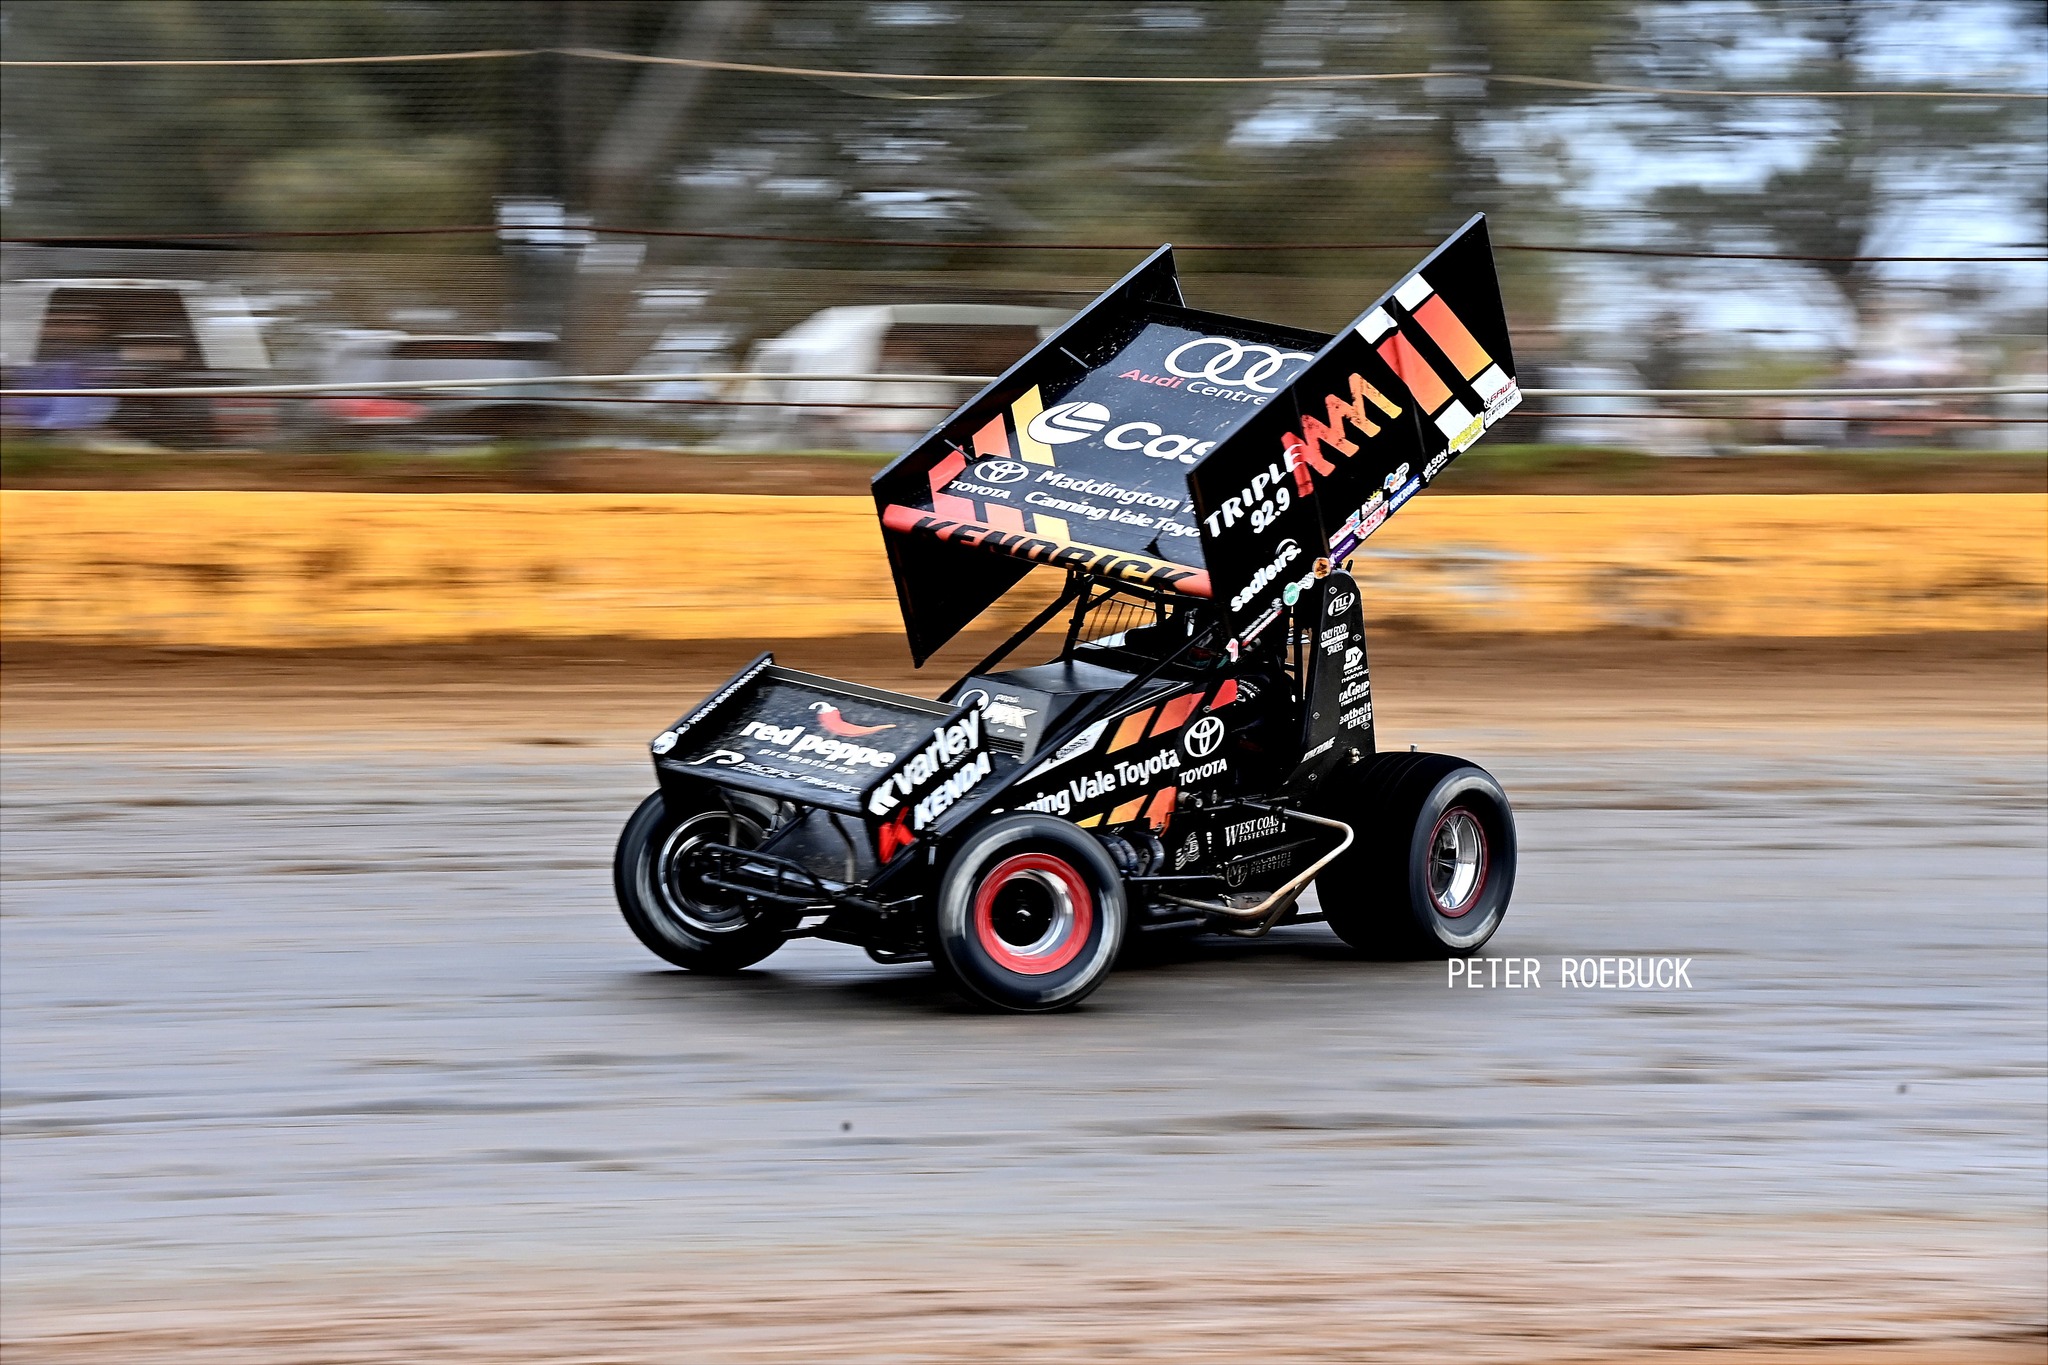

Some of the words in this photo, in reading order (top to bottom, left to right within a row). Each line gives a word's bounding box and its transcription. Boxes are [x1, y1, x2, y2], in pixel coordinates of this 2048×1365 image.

[1118, 369, 1185, 389] Audi
[1186, 381, 1268, 406] Centre
[949, 480, 1012, 500] TOYOTA
[1034, 470, 1181, 510] Maddington
[1203, 443, 1303, 538] TRIPLE
[1024, 491, 1110, 521] Canning
[1108, 508, 1154, 527] Vale
[1251, 487, 1291, 534] 92.9
[1344, 664, 1363, 676] YOUNG
[739, 721, 806, 746] red
[788, 734, 897, 768] peppe
[756, 748, 858, 775] promotions
[1069, 770, 1116, 804] Vale
[1114, 748, 1181, 787] Toyota
[1178, 758, 1228, 786] TOYOTA
[914, 751, 992, 830] KENDA
[1224, 818, 1257, 847] WEST
[1238, 826, 1279, 843] FASTENERS
[1250, 858, 1292, 876] PRESTIGE
